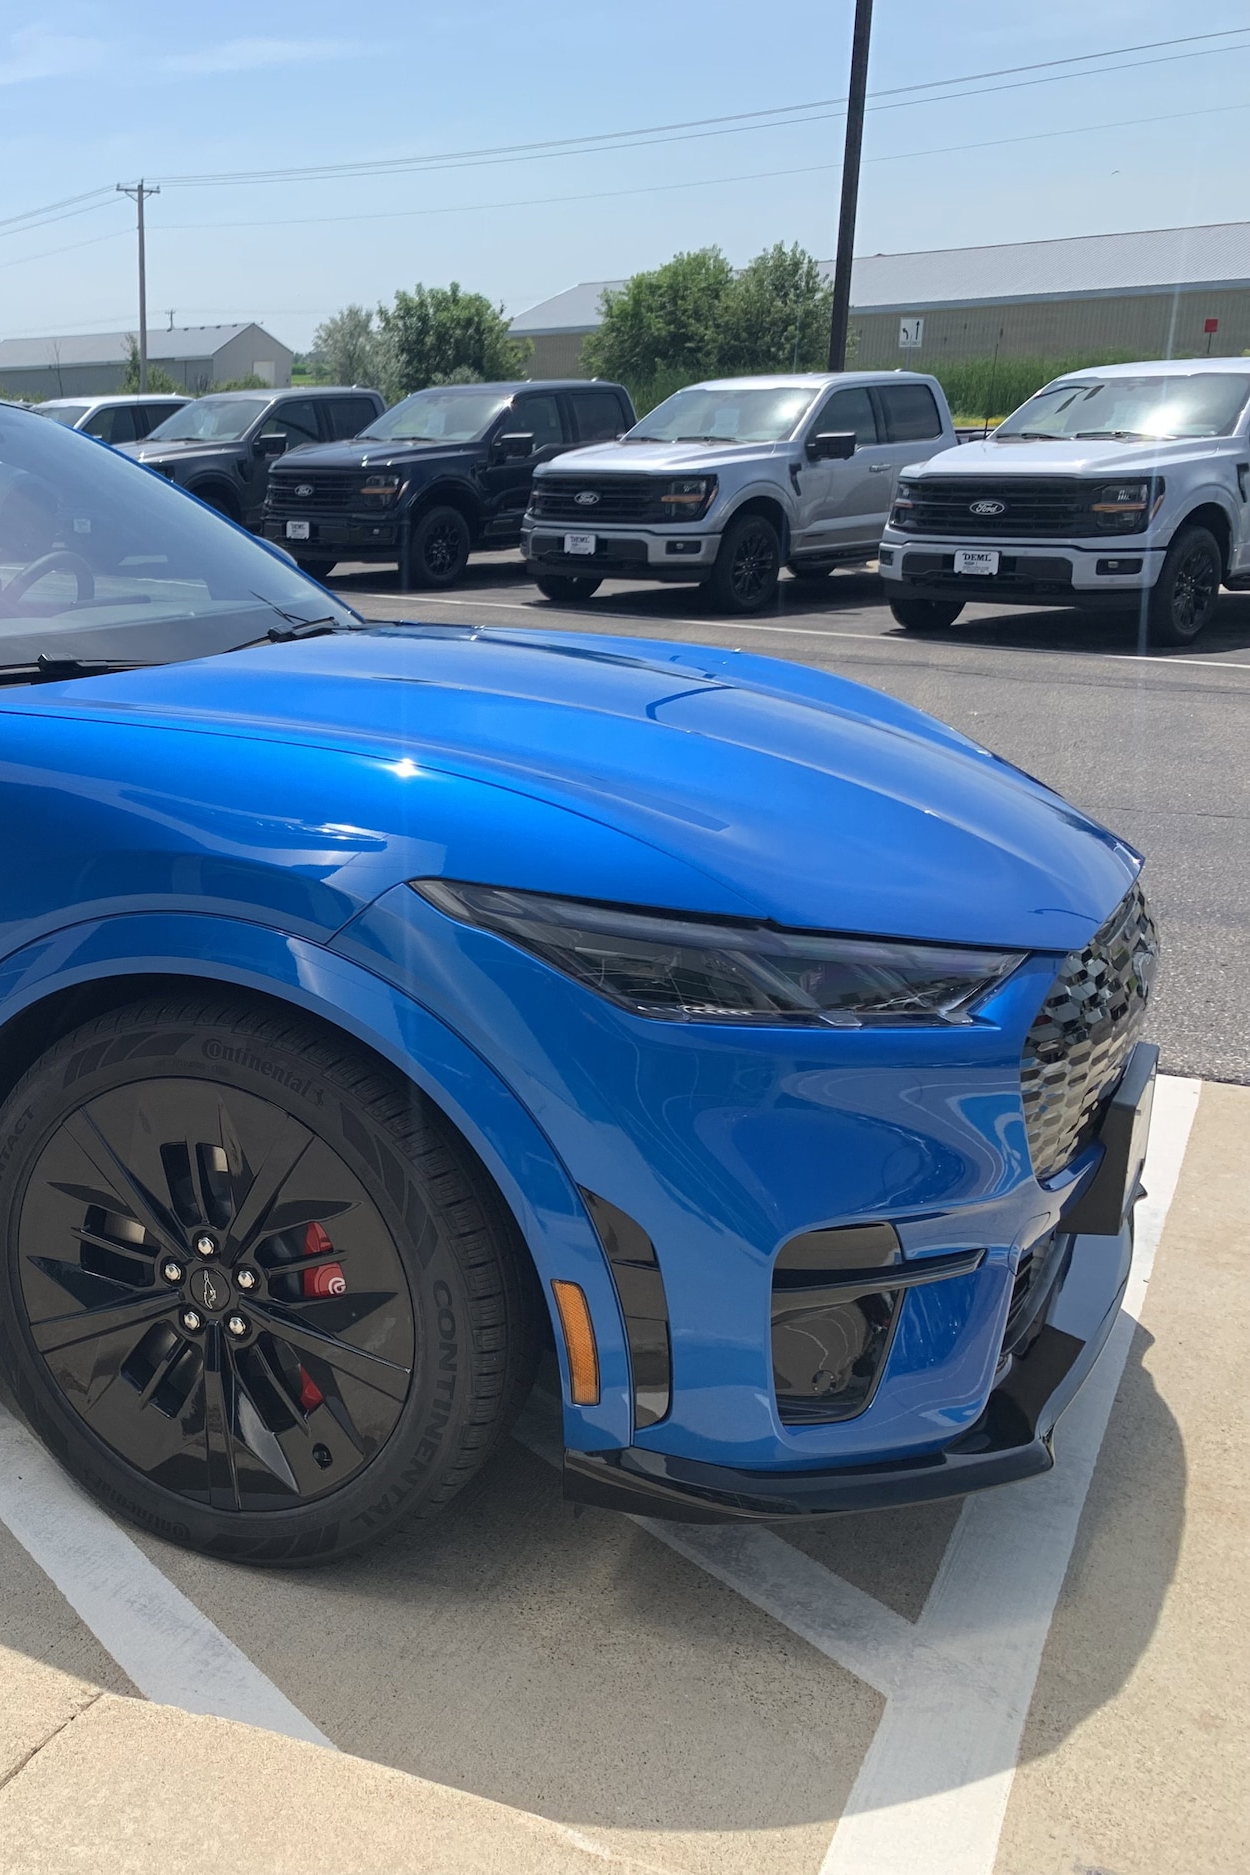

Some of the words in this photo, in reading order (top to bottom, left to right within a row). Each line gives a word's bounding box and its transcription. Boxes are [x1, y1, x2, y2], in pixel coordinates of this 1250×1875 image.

[963, 552, 992, 561] DEML
[202, 1038, 312, 1098] Continental
[351, 1279, 458, 1528] CONTINENTAL
